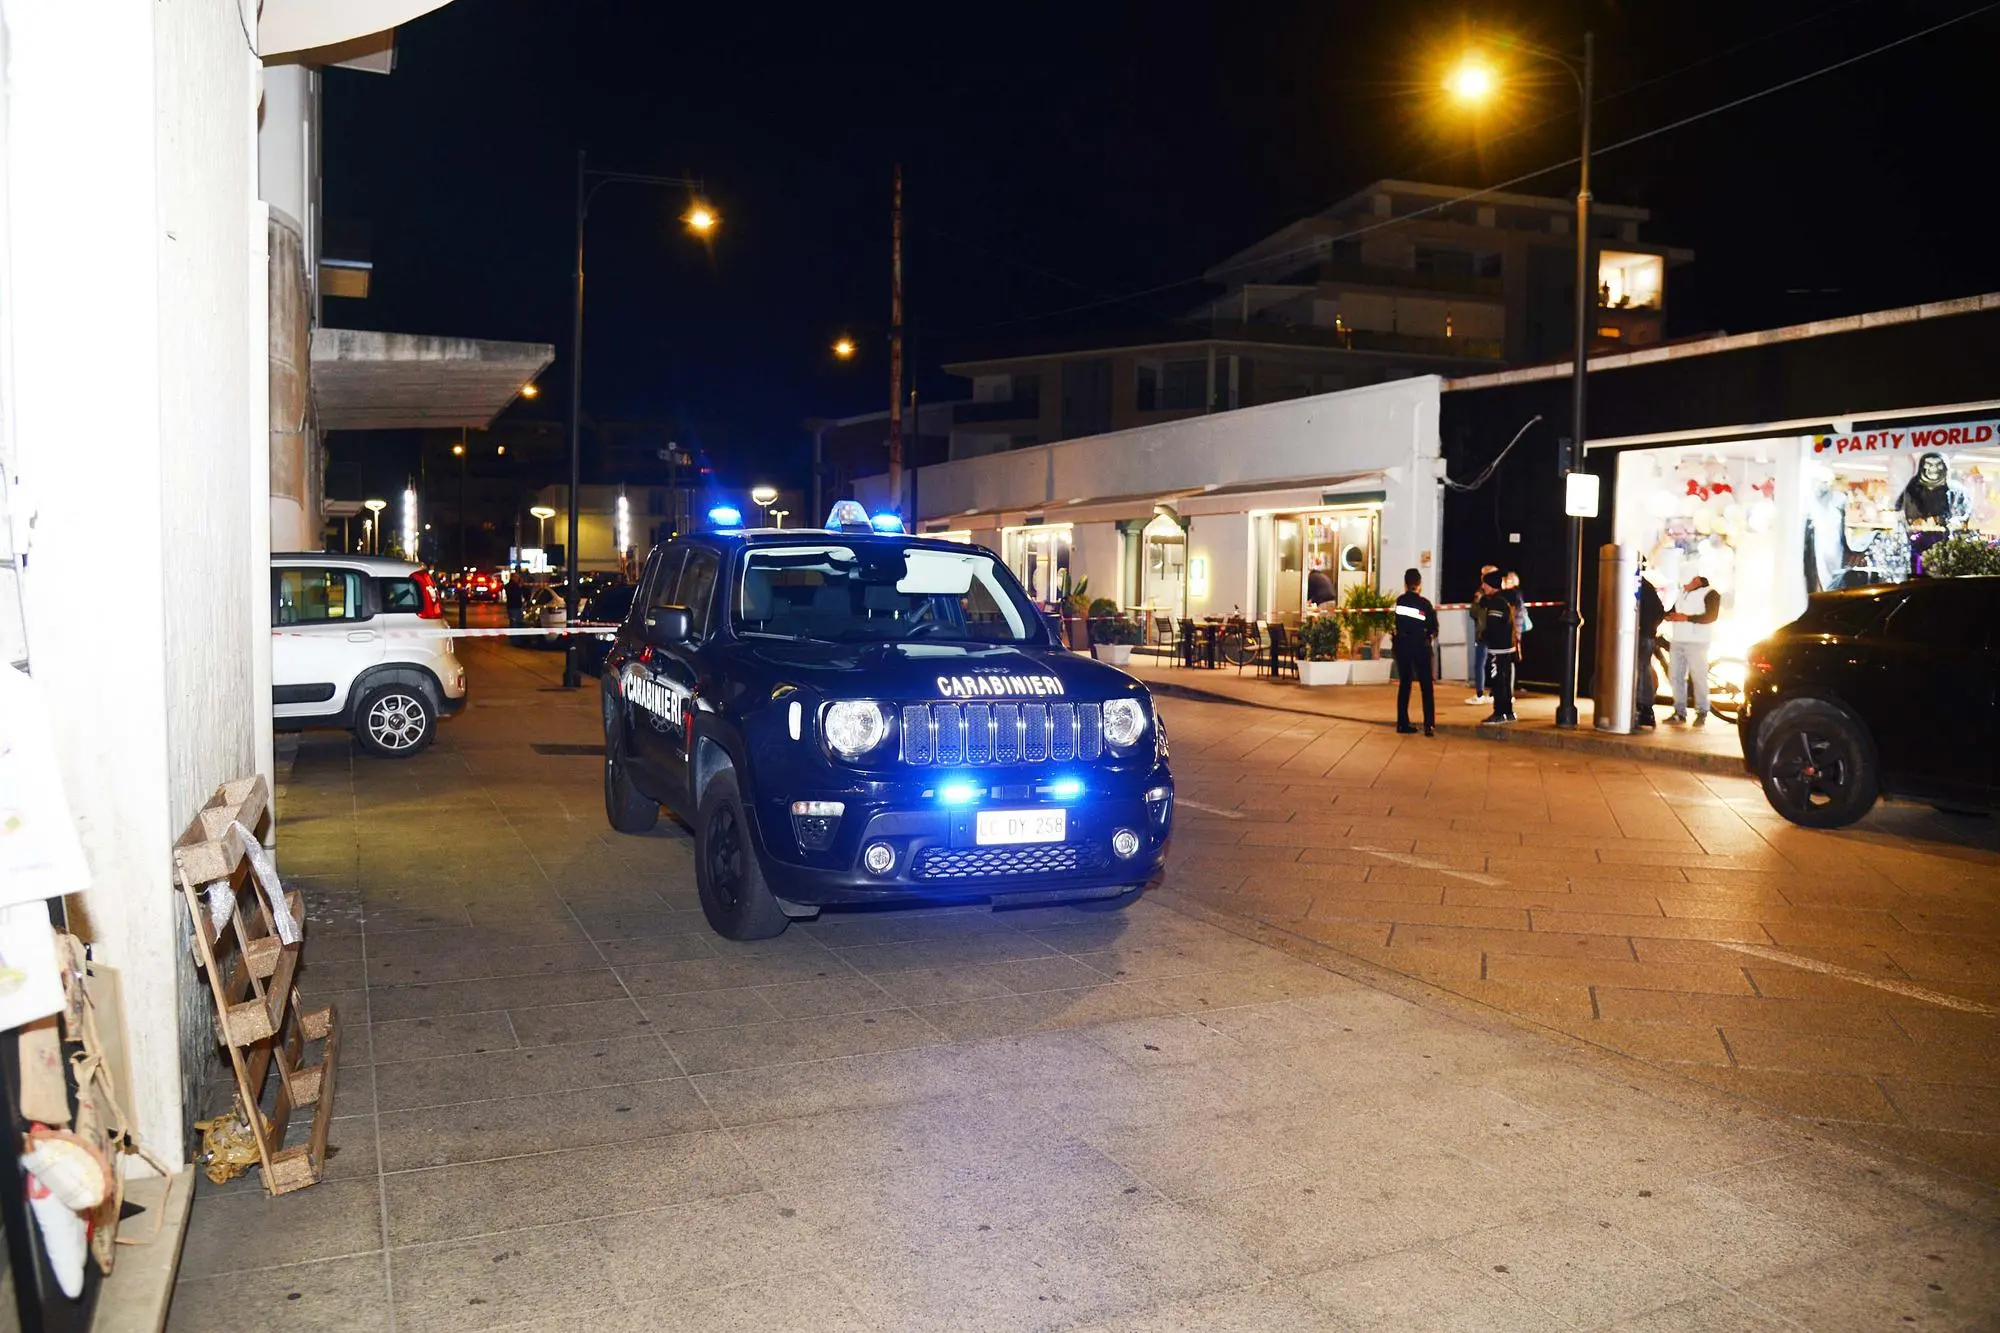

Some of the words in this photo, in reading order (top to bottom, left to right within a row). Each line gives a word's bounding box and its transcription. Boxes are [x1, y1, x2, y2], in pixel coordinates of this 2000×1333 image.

[1836, 431, 1905, 454] PARTY
[1911, 425, 1993, 448] WORLD
[937, 675, 1065, 697] CARABINIERI
[626, 672, 682, 726] CARABINIERI
[1008, 818, 1027, 836] DY
[1036, 816, 1063, 834] 258
